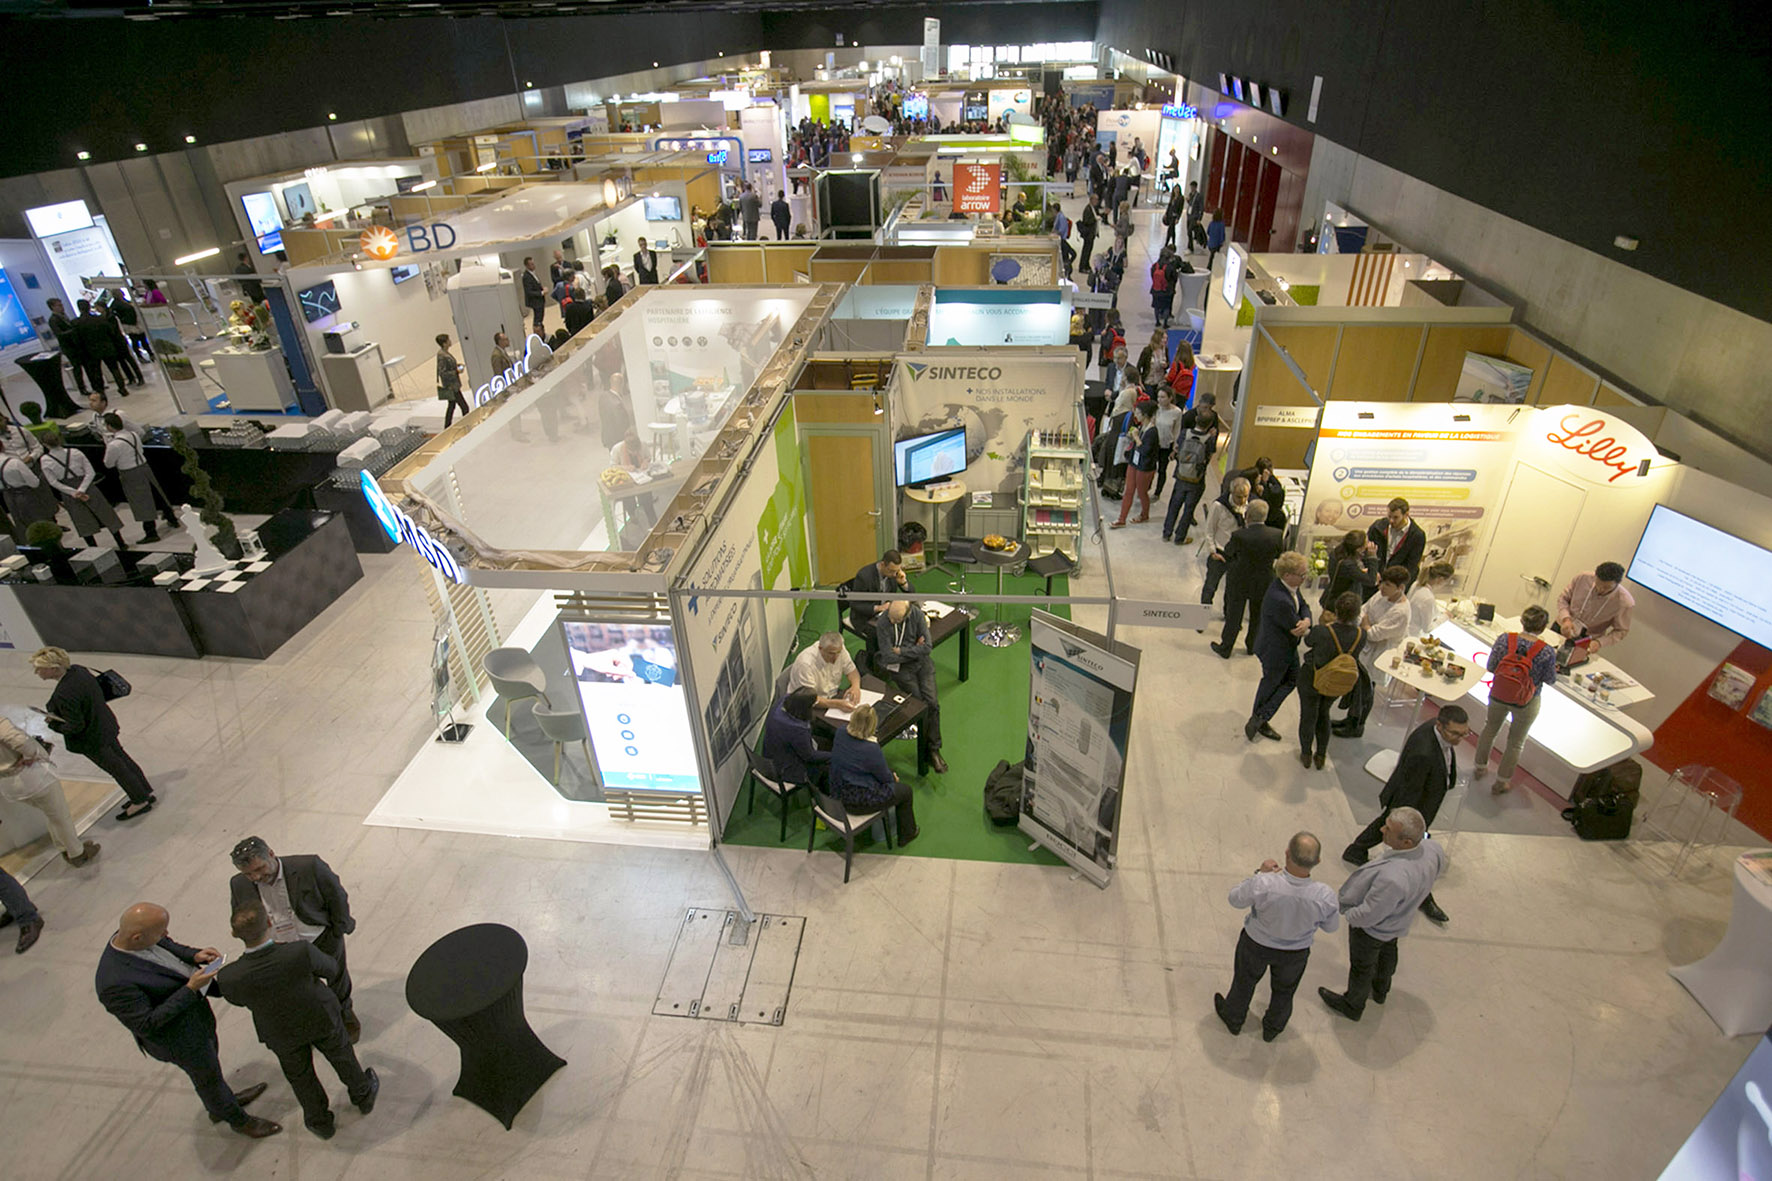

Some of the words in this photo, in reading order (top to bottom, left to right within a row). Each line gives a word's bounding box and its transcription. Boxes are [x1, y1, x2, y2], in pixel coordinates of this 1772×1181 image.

[960, 201, 991, 210] arrow
[406, 222, 456, 253] BD
[928, 366, 1002, 380] SINTECO
[1547, 414, 1637, 482] Lilly
[702, 539, 727, 586] SOLUTIONS
[1143, 610, 1181, 619] SINTECO
